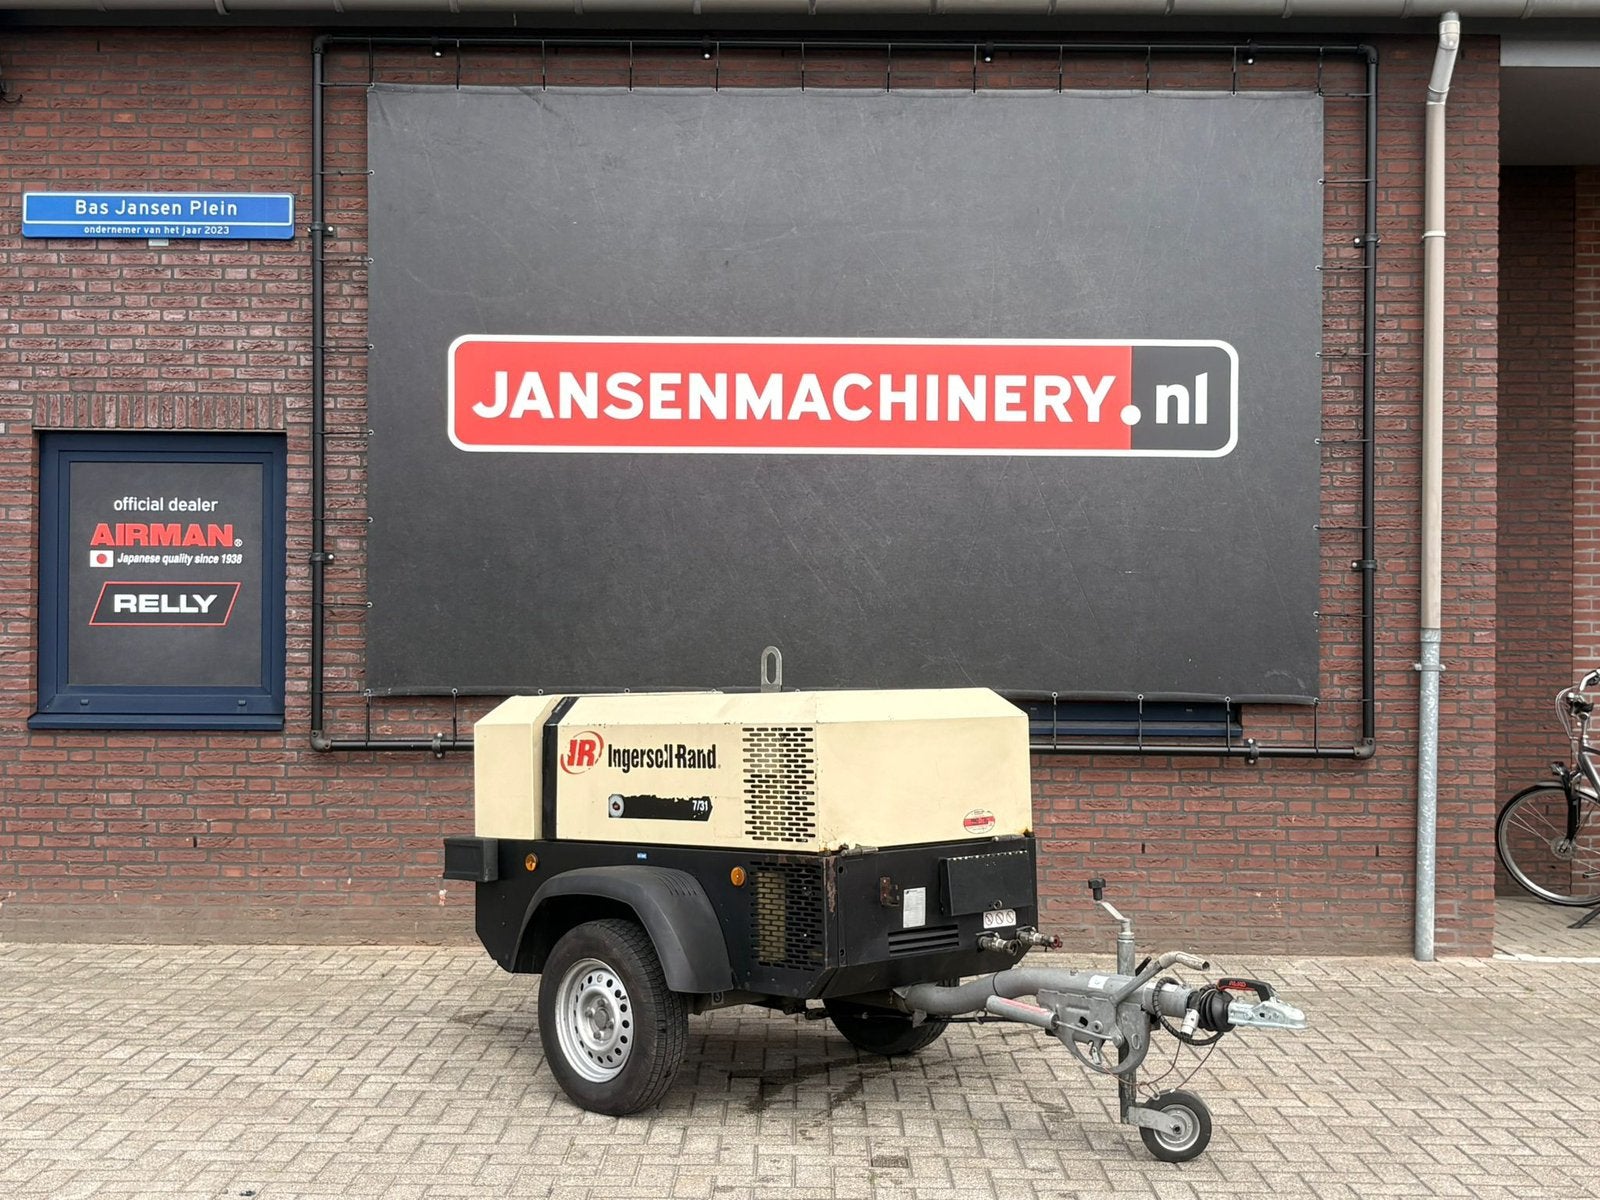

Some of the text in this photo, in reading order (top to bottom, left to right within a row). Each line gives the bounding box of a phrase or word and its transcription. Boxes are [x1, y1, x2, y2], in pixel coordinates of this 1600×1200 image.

[75, 199, 237, 216] Bas Jansen Plein
[84, 225, 230, 237] ondernemer van het jaar 2023
[113, 497, 219, 512] official dealer
[90, 523, 234, 547] AIRMAN
[117, 552, 243, 566] Japanese quality since 1938
[113, 594, 218, 613] RELLY
